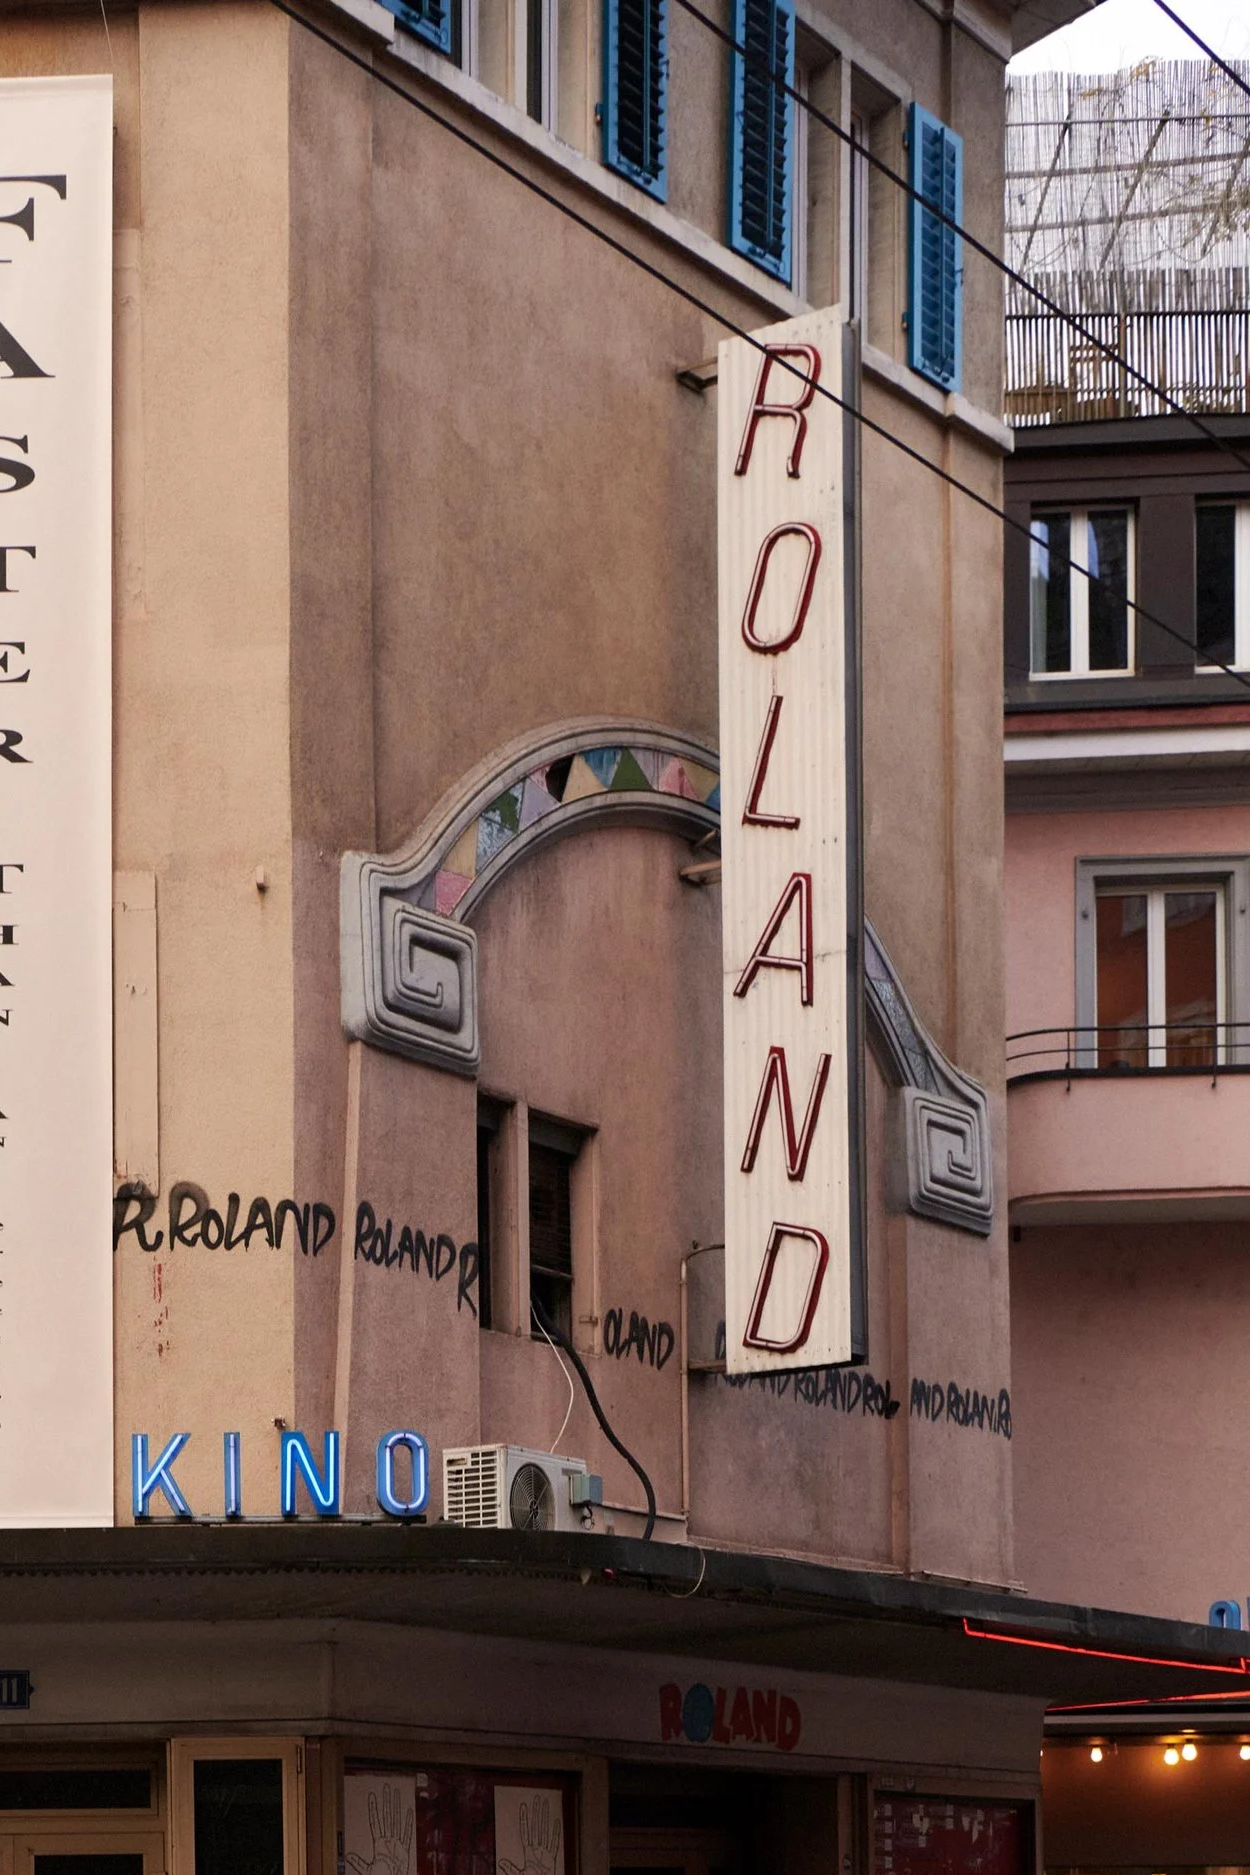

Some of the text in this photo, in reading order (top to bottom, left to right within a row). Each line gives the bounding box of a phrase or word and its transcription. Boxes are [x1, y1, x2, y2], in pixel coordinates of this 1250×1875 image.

[734, 342, 829, 1354] ROLAND
[132, 1429, 429, 1517] KINO
[658, 1683, 801, 1751] ROLAND
